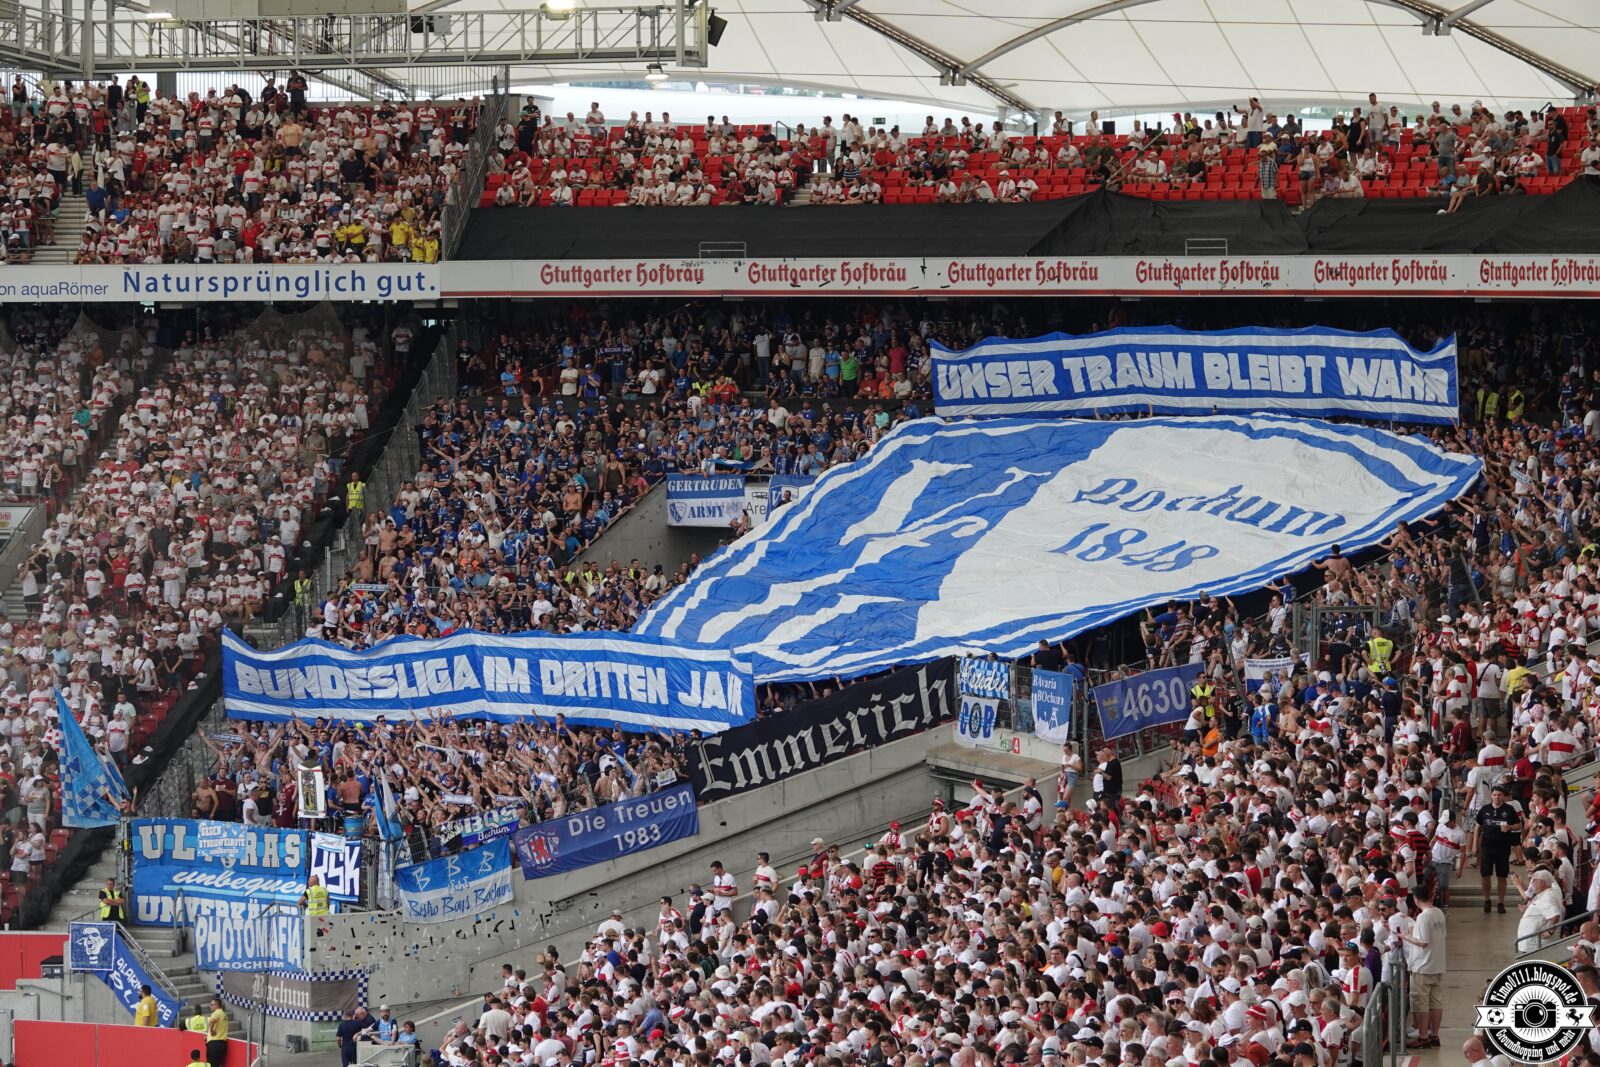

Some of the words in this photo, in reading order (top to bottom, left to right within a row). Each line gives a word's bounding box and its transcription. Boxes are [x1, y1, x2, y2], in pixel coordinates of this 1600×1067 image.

[123, 271, 365, 298] Natursprünglich
[376, 271, 436, 297] gut.
[540, 264, 633, 288] Stuttgarter
[747, 262, 839, 288] Stuttgarter
[841, 262, 907, 285] Hofbräu
[947, 261, 1032, 288] Stuttgarter
[1035, 260, 1098, 285] Hofbräu
[1135, 260, 1216, 287] Stuttgarter
[1219, 260, 1280, 285] Hofbräu
[1314, 259, 1389, 287] Stuttgarter
[1391, 259, 1447, 285] Hofbräu
[1479, 259, 1548, 287] Stuttgarter
[21, 281, 109, 299] aquaRömer
[936, 358, 1060, 400] UNSER
[1063, 351, 1195, 393] TRAUM
[1202, 351, 1327, 394] BLEIBT
[1336, 355, 1449, 404] WAHR
[667, 478, 744, 492] GERTRUDEN
[687, 505, 725, 518] ARMY
[1071, 478, 1346, 537] Bochum
[1047, 522, 1220, 572] 1848
[235, 654, 482, 700] BUNDESLIGA
[482, 655, 531, 694] IM
[541, 661, 669, 704] DRITTEN
[1122, 676, 1187, 722] 4630
[698, 666, 951, 795] Emmerich
[568, 815, 606, 837] Die
[613, 790, 692, 824] Treuen
[138, 824, 301, 868] ULRAS
[478, 825, 511, 841] Bochum
[613, 824, 661, 851] 1983
[195, 915, 302, 968] PHOTOMAFIA
[218, 960, 284, 970] BOCHUM
